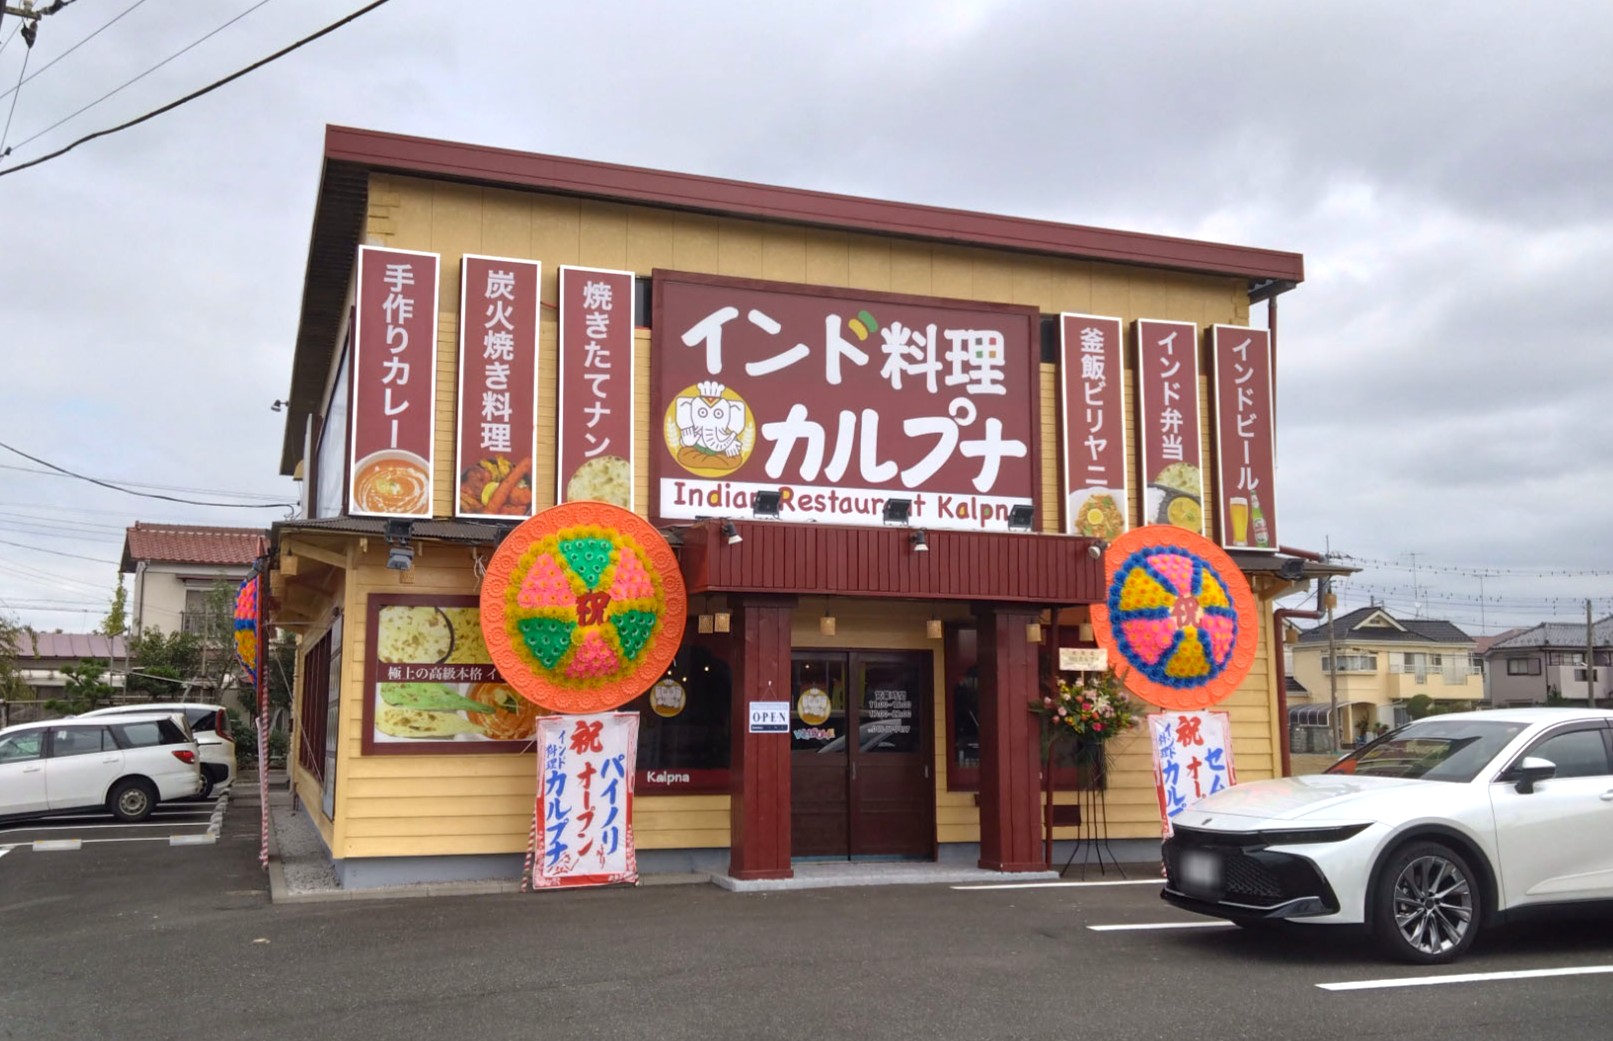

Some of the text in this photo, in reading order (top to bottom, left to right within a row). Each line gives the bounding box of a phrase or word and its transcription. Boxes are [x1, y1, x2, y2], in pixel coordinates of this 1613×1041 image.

[382, 264, 415, 449] 手作りカレー
[480, 269, 515, 453] 炭火焼き料理
[582, 281, 613, 458] 焼きたてナン
[681, 306, 1006, 395] インド料理
[1158, 331, 1184, 461] インド弁当
[761, 397, 1027, 493] カルプナ
[1080, 327, 1108, 485] 釜飯ビリヤニ
[1232, 338, 1259, 491] インドビール
[778, 486, 926, 517] Restaurt
[938, 495, 1009, 528] Kalpn
[388, 666, 482, 681] 極上の高級本格
[569, 720, 604, 857] 祝 オープン
[600, 753, 625, 855] パイノリ
[647, 770, 690, 786] Kalpna
[1176, 715, 1207, 798] 祝 オー
[546, 770, 573, 868] カルプナ
